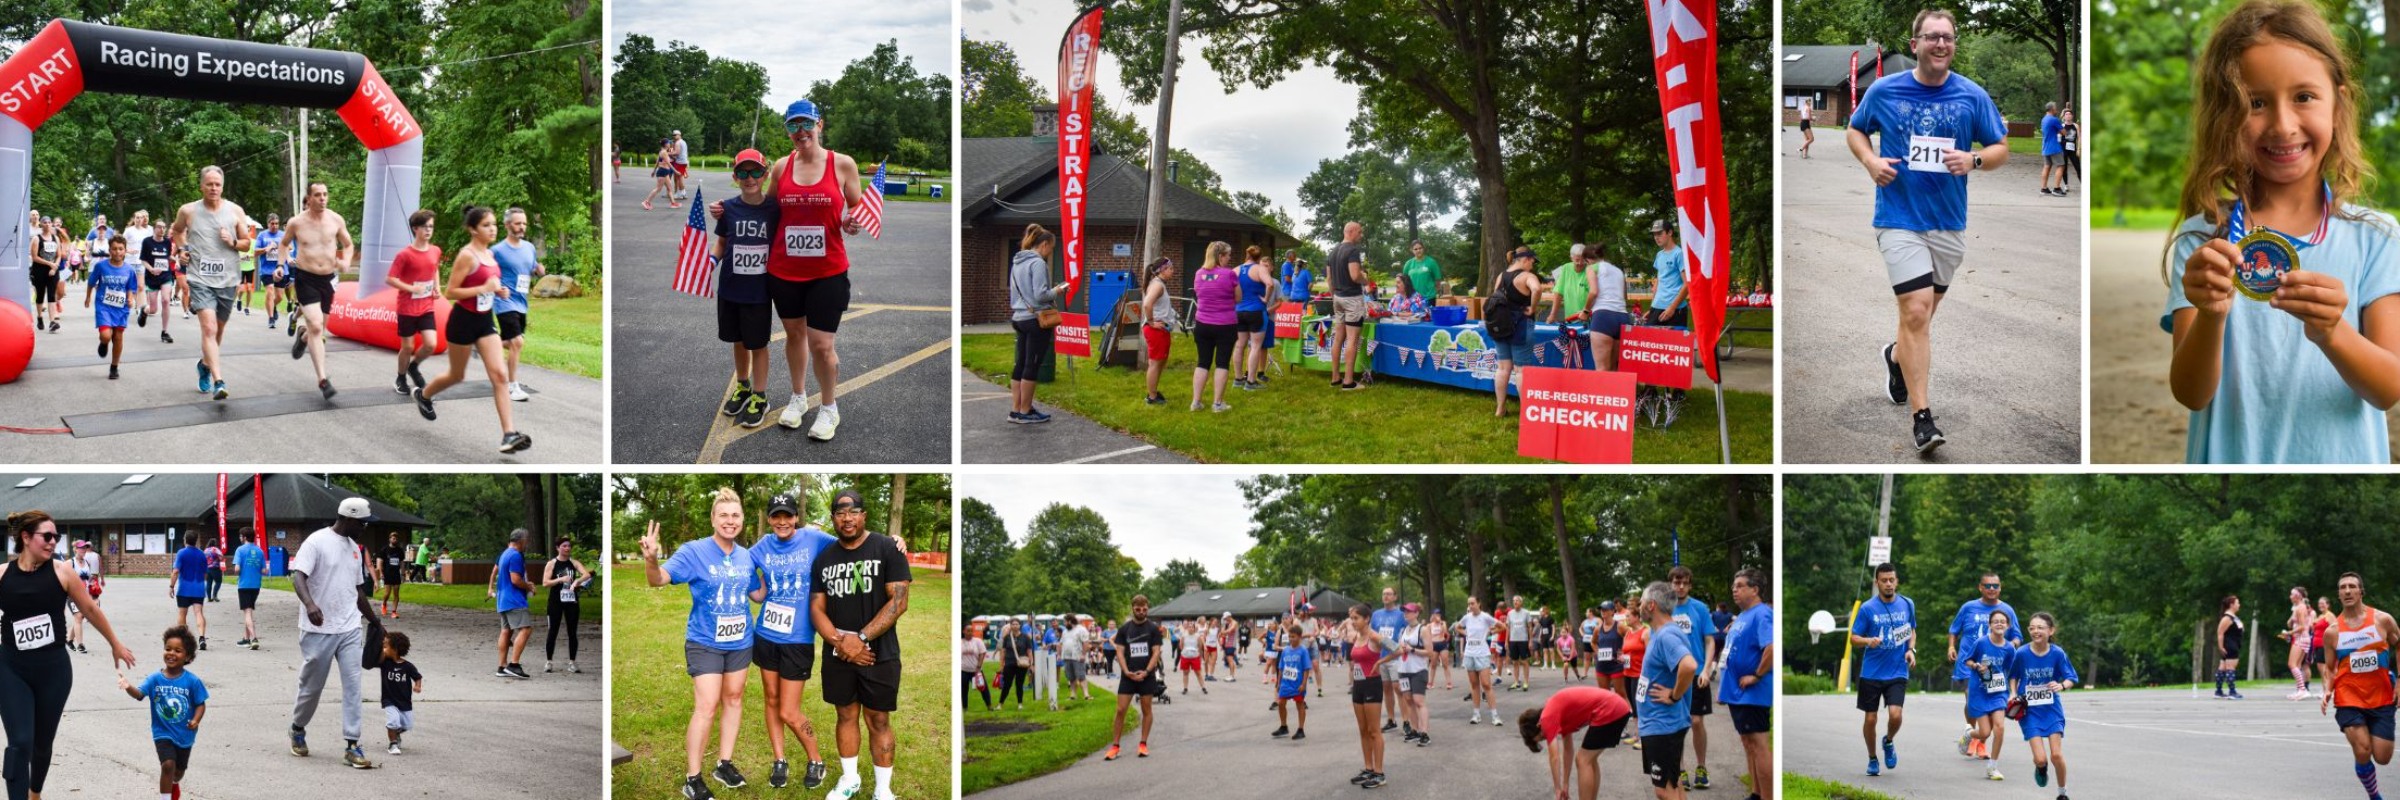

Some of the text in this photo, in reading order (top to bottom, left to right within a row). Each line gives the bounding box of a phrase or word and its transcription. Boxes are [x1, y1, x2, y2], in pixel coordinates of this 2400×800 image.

[100, 40, 346, 86] Racing Expectations
[0, 47, 74, 113] START
[362, 78, 414, 139] START
[1911, 145, 1945, 164] 211
[735, 220, 768, 239] USA
[787, 234, 824, 250] 2023
[200, 262, 224, 273] 2100
[734, 253, 767, 268] 2024
[106, 292, 125, 304] 2013
[1276, 313, 1300, 323] NSITE
[1056, 324, 1088, 338] ONSITE
[1622, 338, 1691, 354] PRE-REGISTERED
[1621, 349, 1690, 368] CHECK-IN
[1526, 389, 1629, 408] PRE-REGISTERED
[1525, 405, 1628, 432] CHECK-IN
[764, 609, 792, 628] 2014
[16, 622, 51, 644] 2057
[717, 622, 746, 637] 2032
[2351, 656, 2377, 668] 2093
[387, 671, 407, 682] USA
[2026, 689, 2052, 701] 2065
